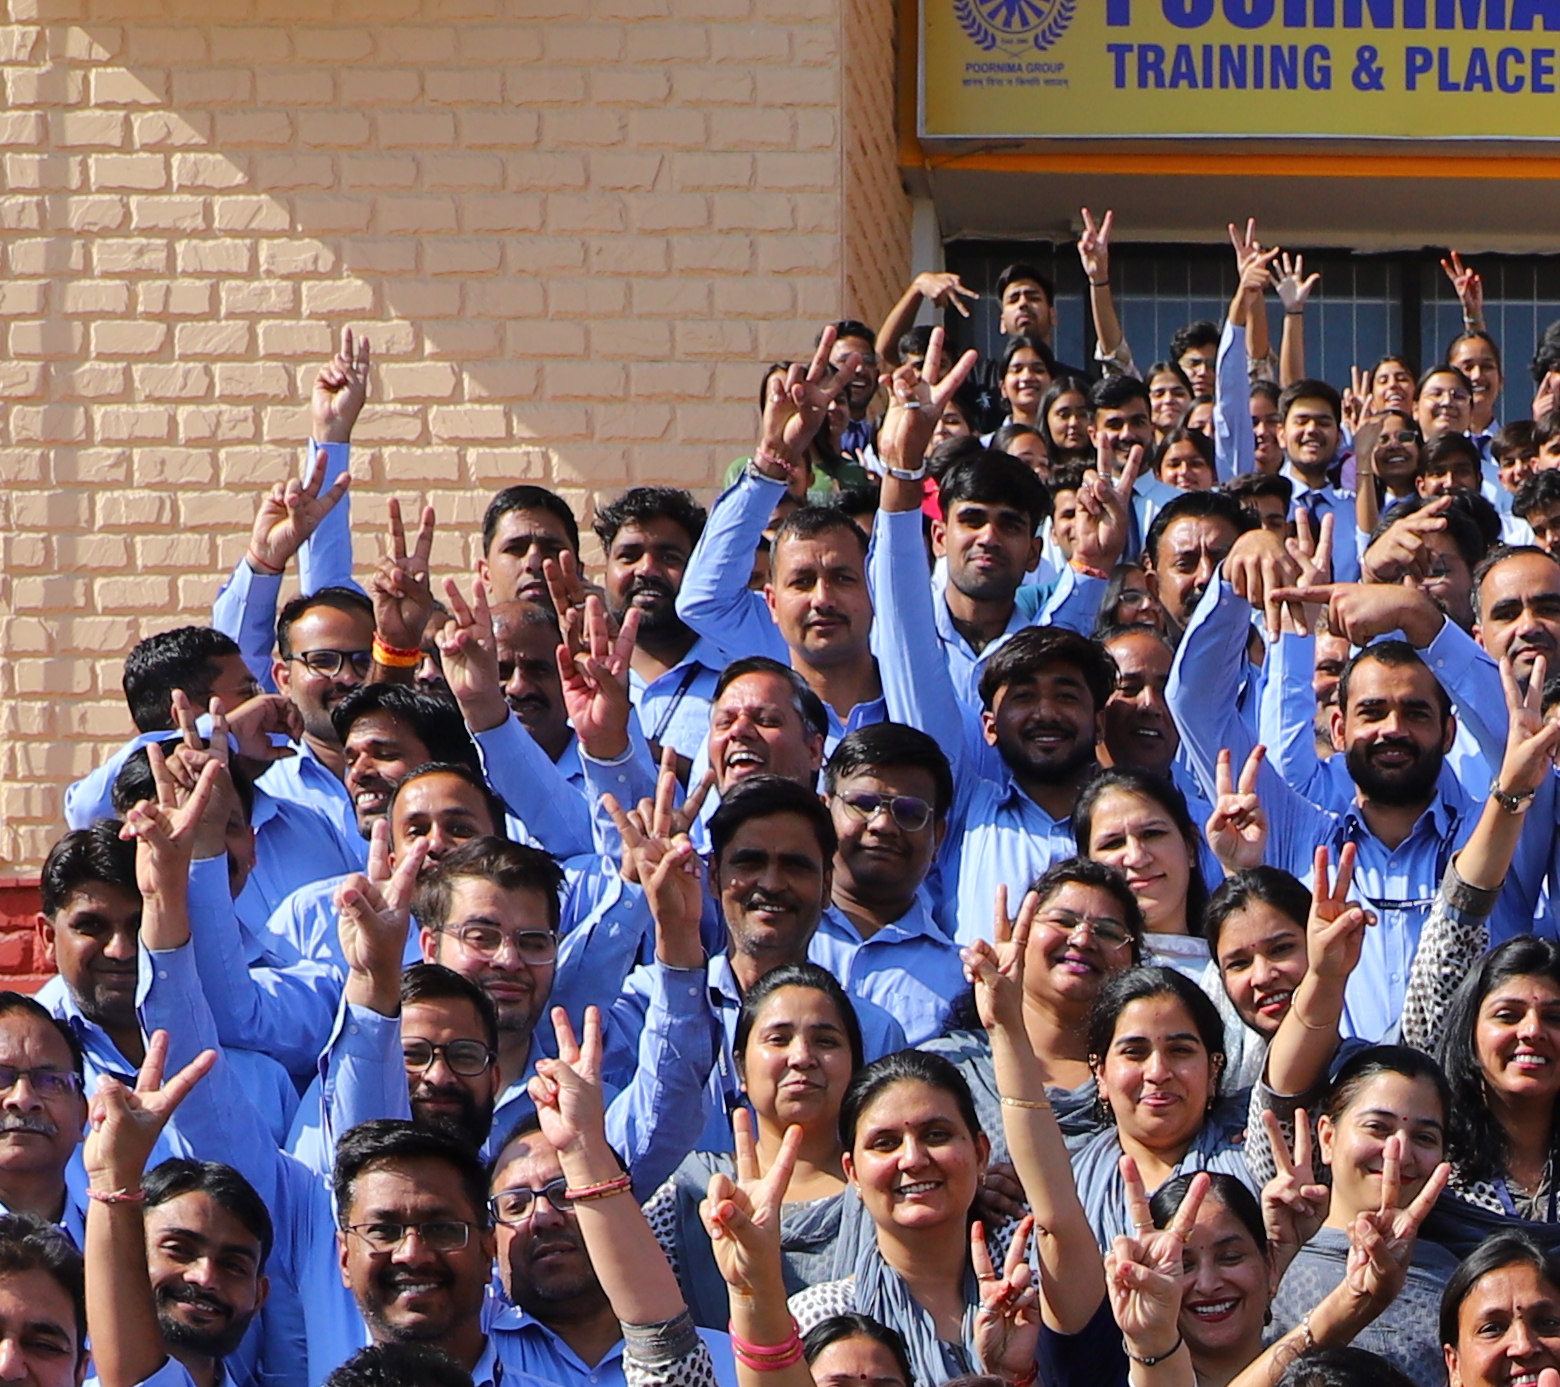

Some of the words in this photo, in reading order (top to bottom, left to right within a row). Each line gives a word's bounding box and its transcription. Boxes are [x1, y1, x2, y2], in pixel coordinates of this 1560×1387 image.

[966, 63, 1022, 74] POORNIMA
[1025, 63, 1065, 74] GROUP
[1106, 43, 1331, 90] TRAINING
[1351, 45, 1385, 91] &
